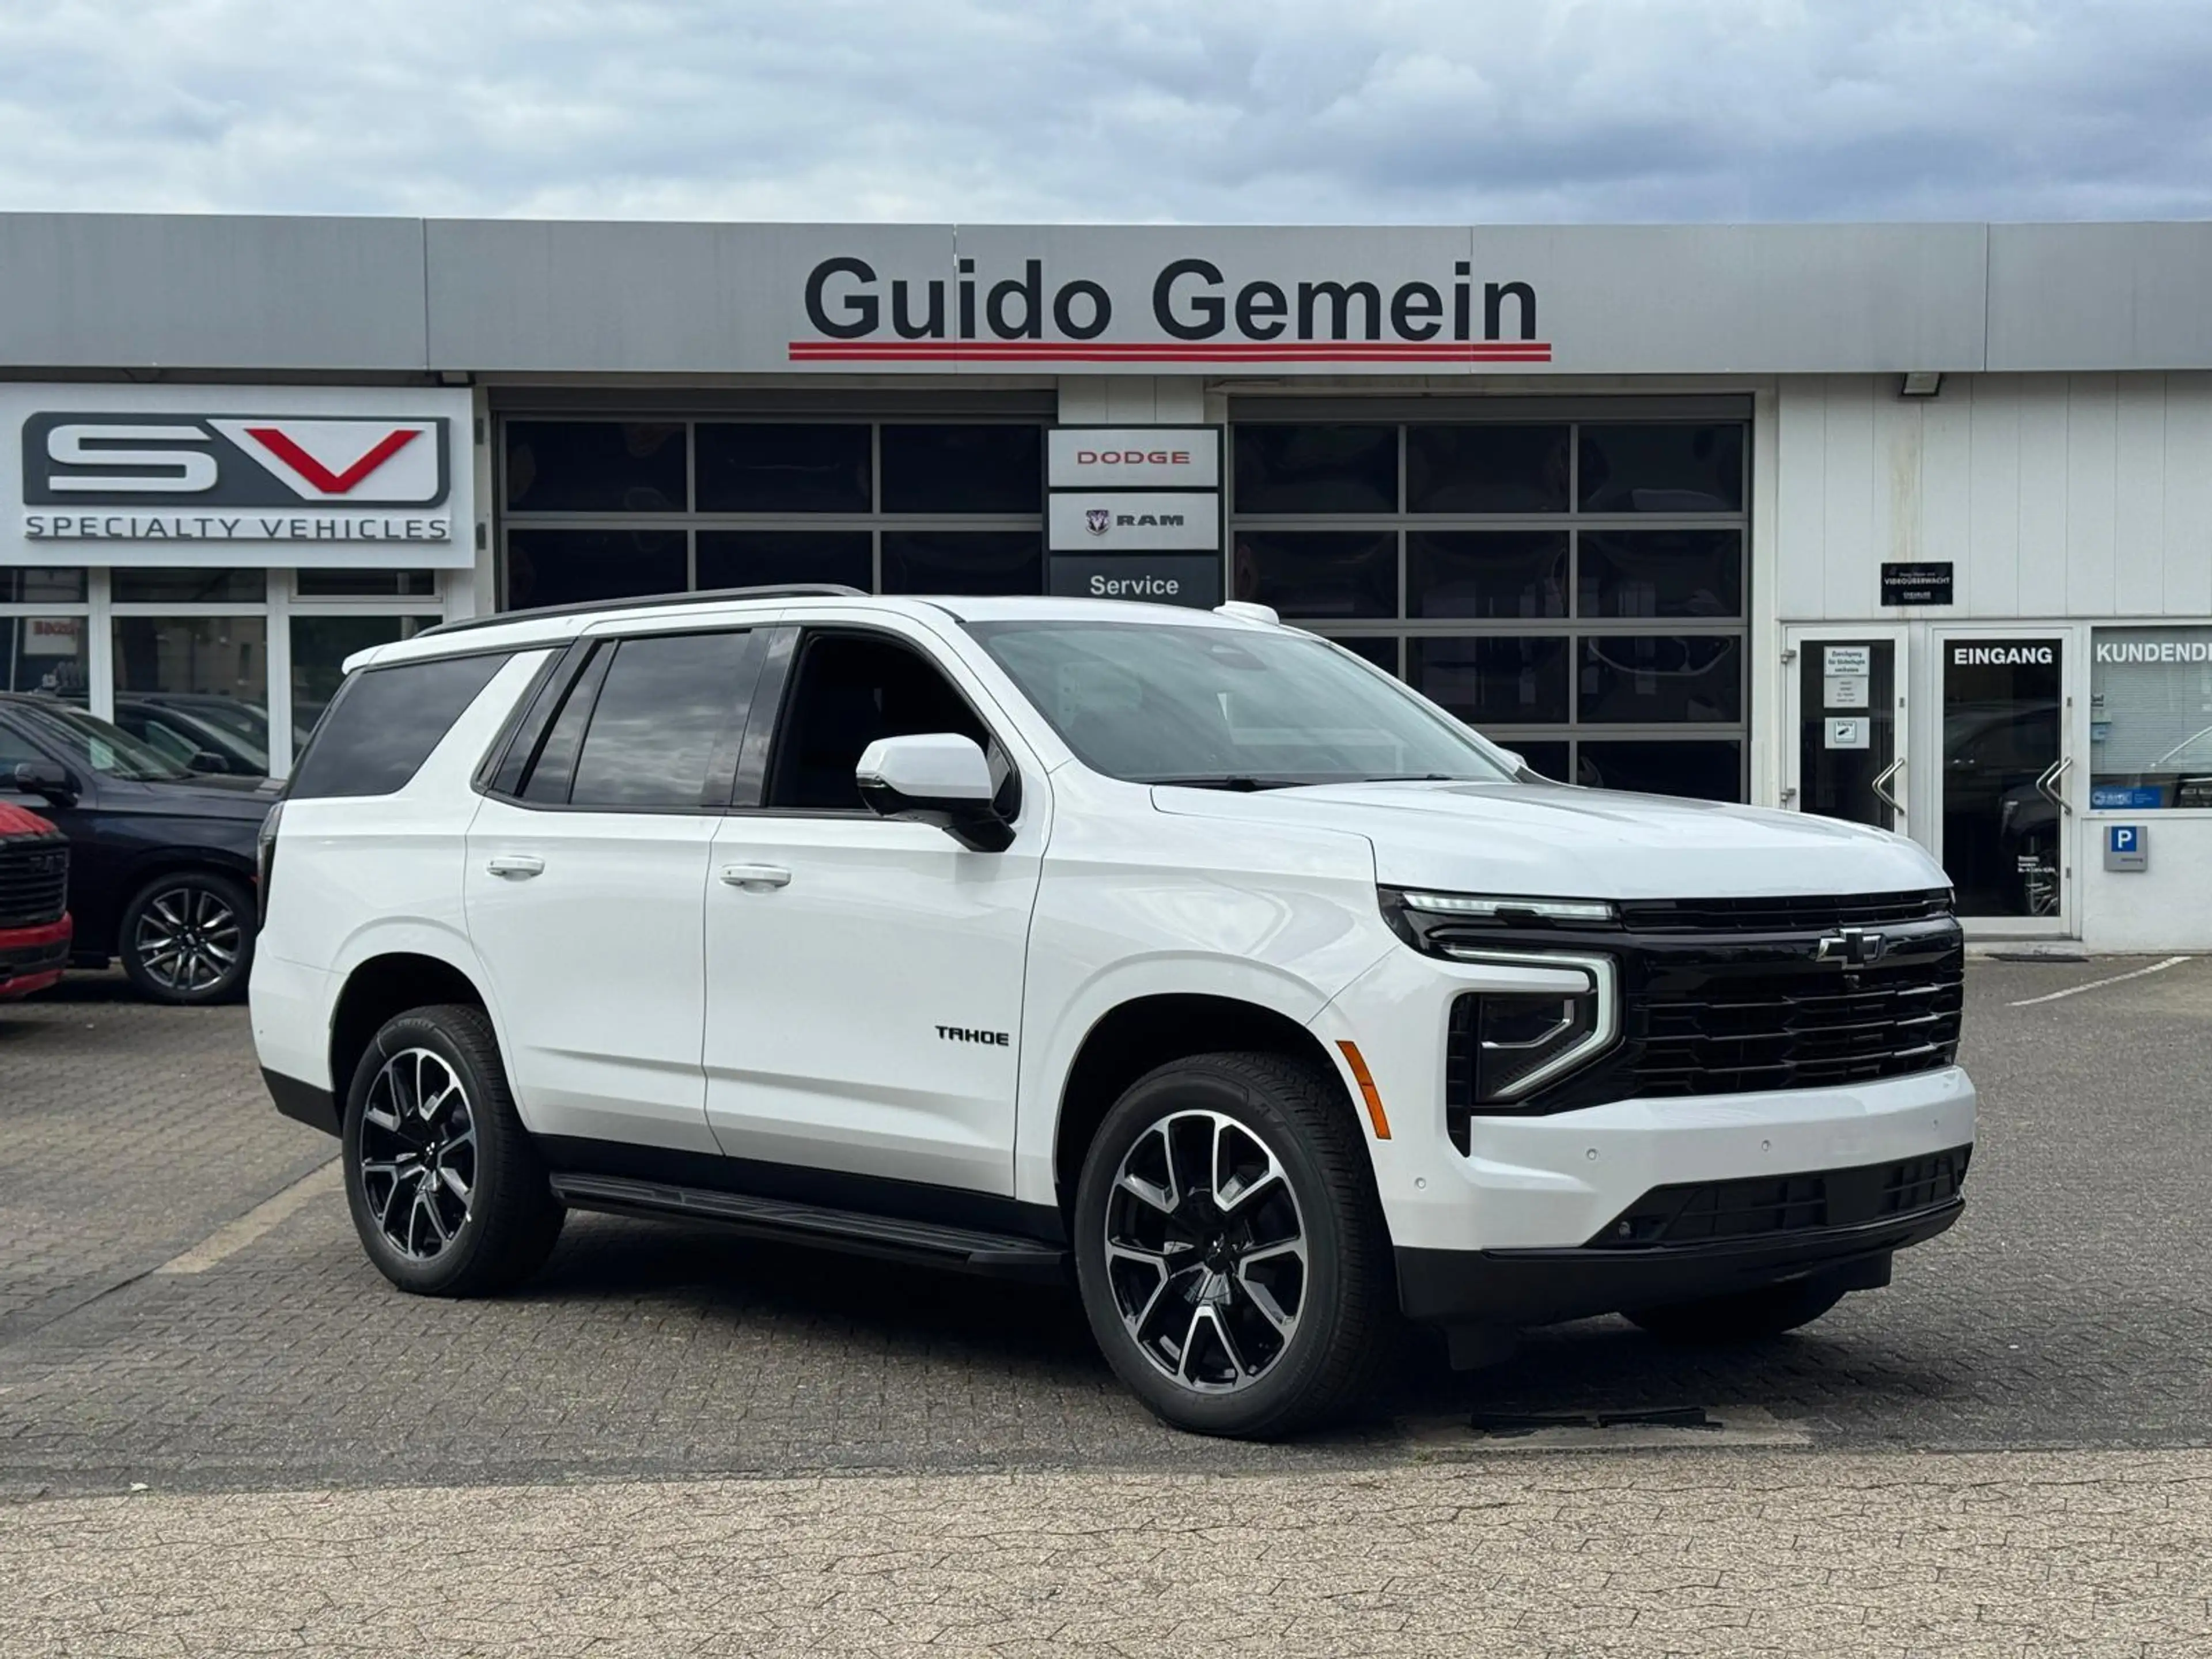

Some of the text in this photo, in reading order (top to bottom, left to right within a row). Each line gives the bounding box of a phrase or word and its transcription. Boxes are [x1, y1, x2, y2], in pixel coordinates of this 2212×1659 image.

[805, 257, 1537, 342] Guido Gemein
[47, 423, 425, 494] SV
[1077, 451, 1191, 464] DODGE
[25, 516, 448, 539] SPECIALTY VEHICLES
[1116, 515, 1184, 527] RAM
[1090, 575, 1180, 595] Service
[1954, 647, 2053, 665] EINGANG
[2118, 829, 2132, 849] P
[934, 1025, 1010, 1047] TAHOE
